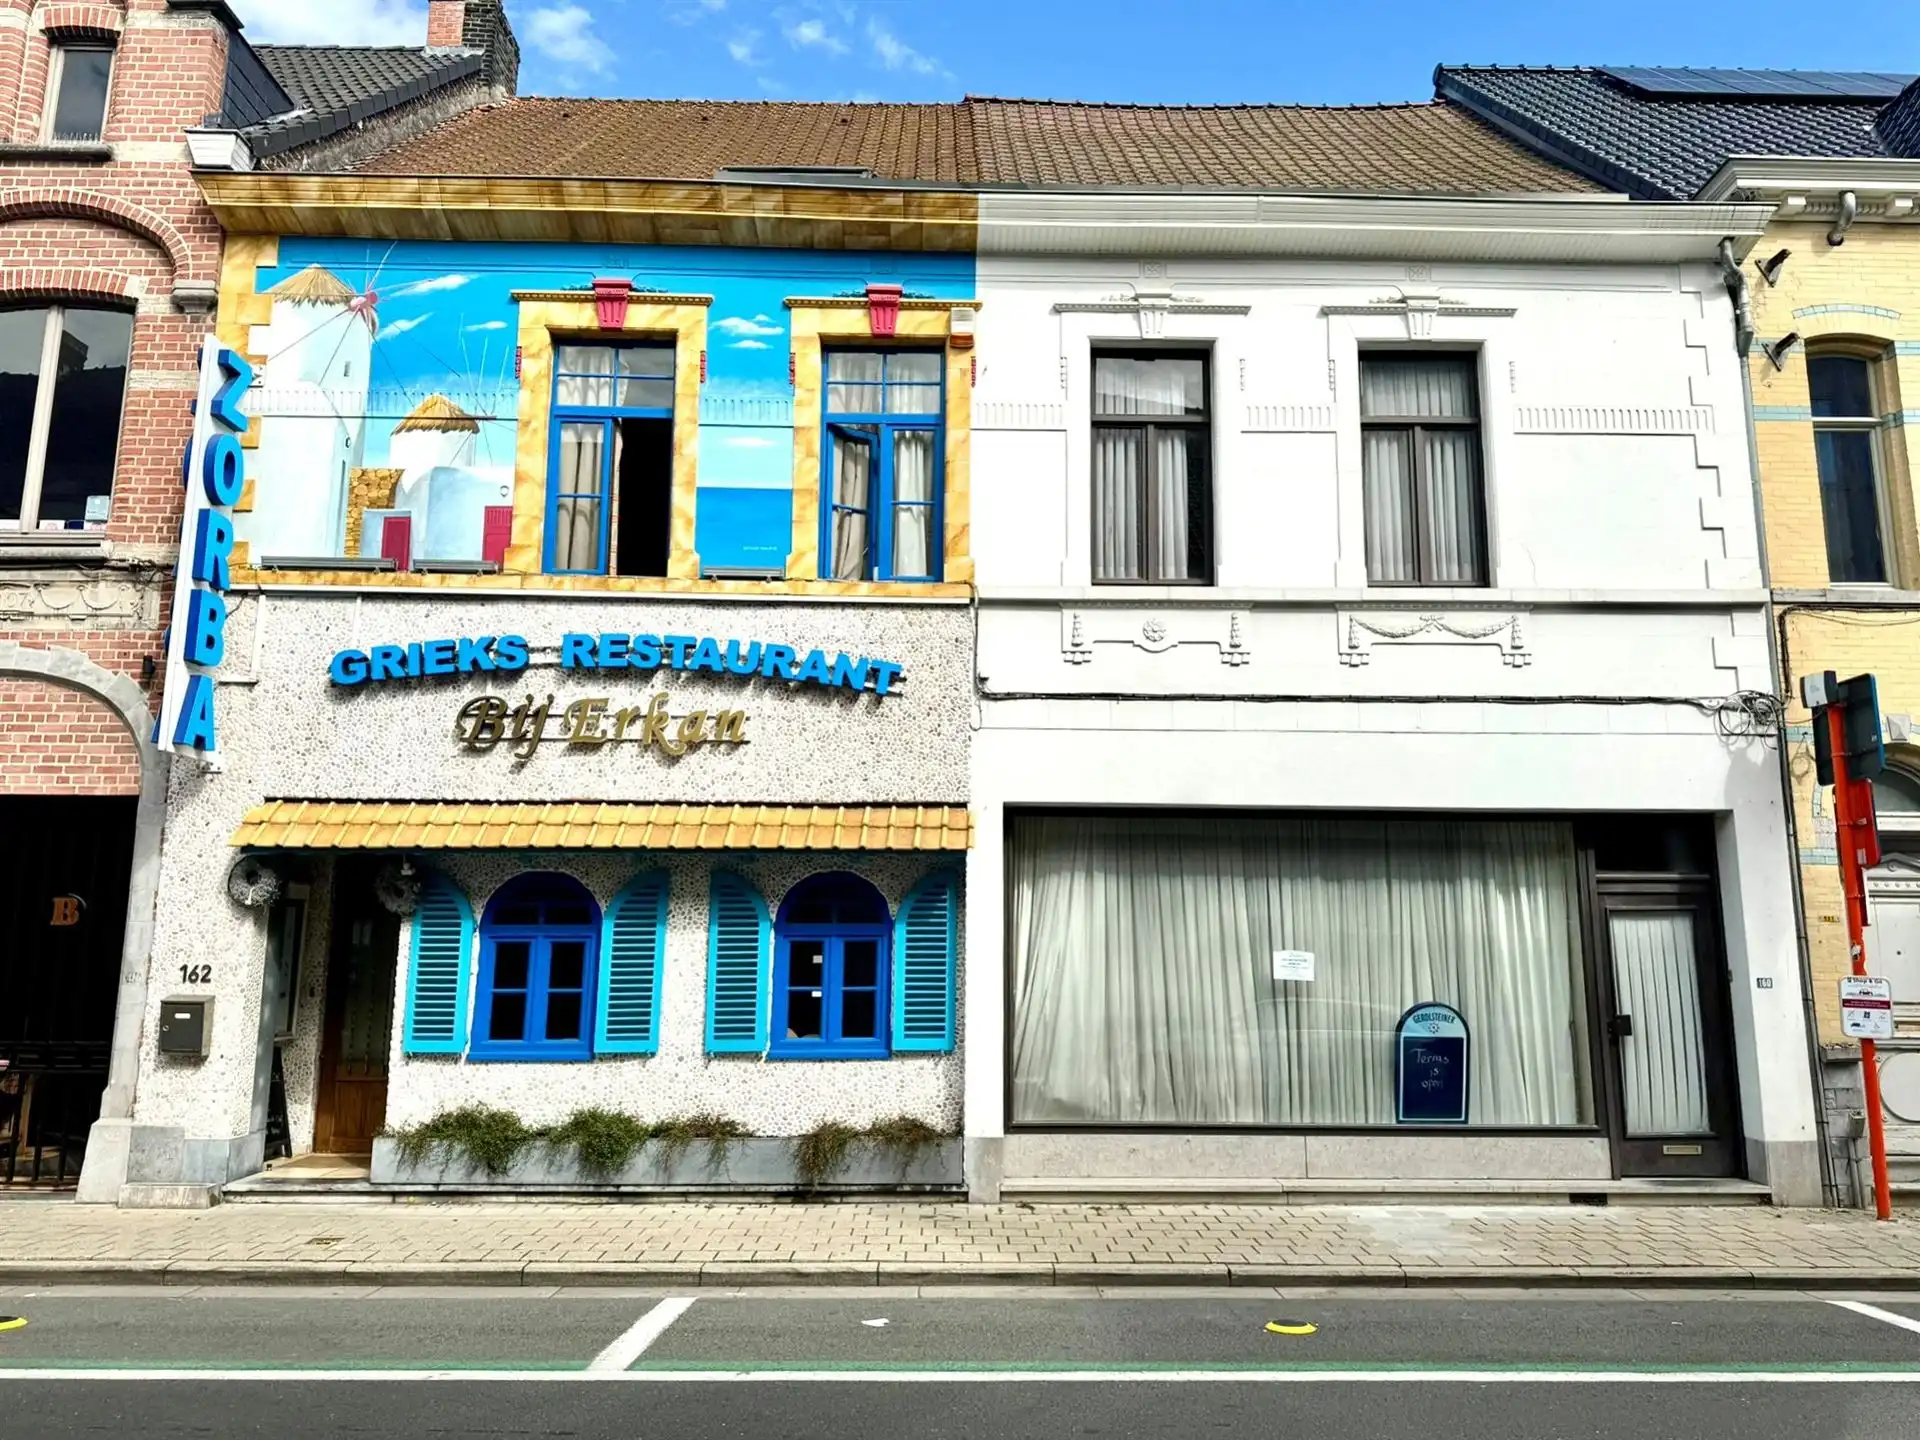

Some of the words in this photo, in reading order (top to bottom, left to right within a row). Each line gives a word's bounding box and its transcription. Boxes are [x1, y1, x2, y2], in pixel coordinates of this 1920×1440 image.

[173, 349, 253, 751] ZORBA
[330, 633, 531, 687] GRIEKS
[561, 633, 906, 697] RESTAURANT
[455, 693, 554, 760] Bij
[562, 692, 748, 756] Erkan
[180, 964, 212, 984] 162
[1413, 1012, 1455, 1024] GEROLSTEINER
